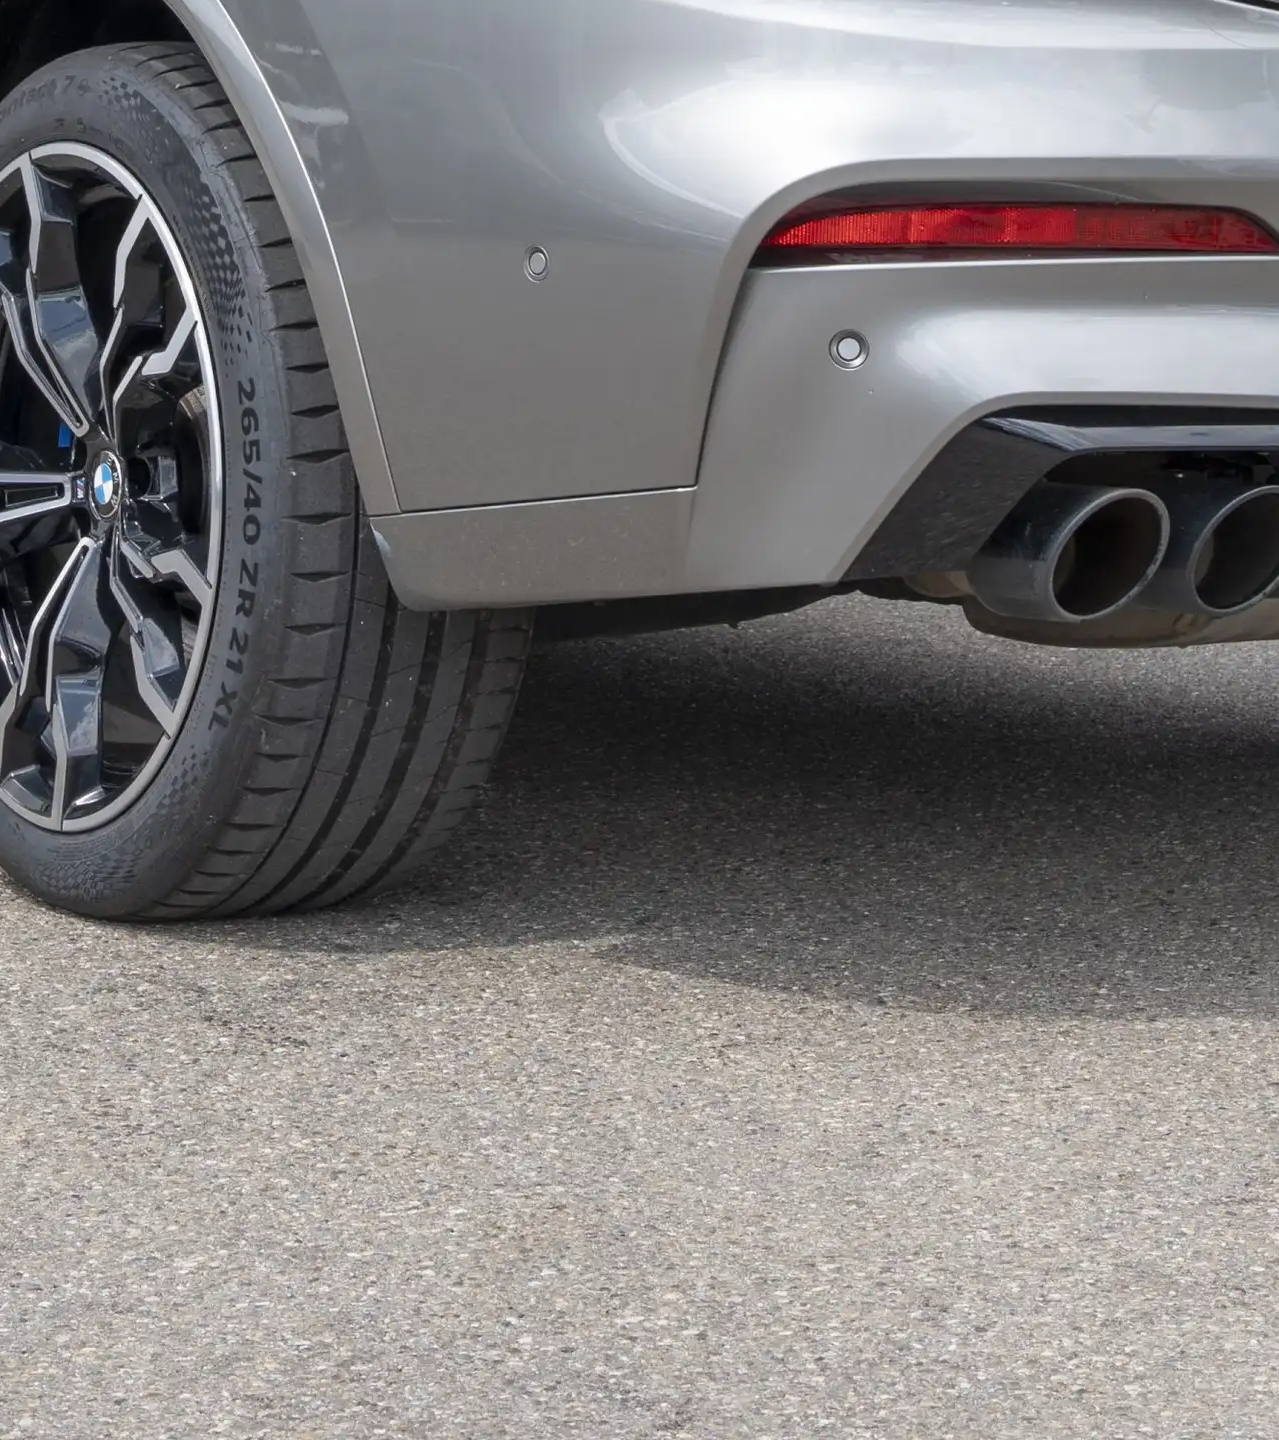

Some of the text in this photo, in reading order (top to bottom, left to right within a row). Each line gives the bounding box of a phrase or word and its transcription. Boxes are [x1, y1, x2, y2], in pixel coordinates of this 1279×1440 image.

[208, 377, 264, 732] 265/40 ZR 21 XL
